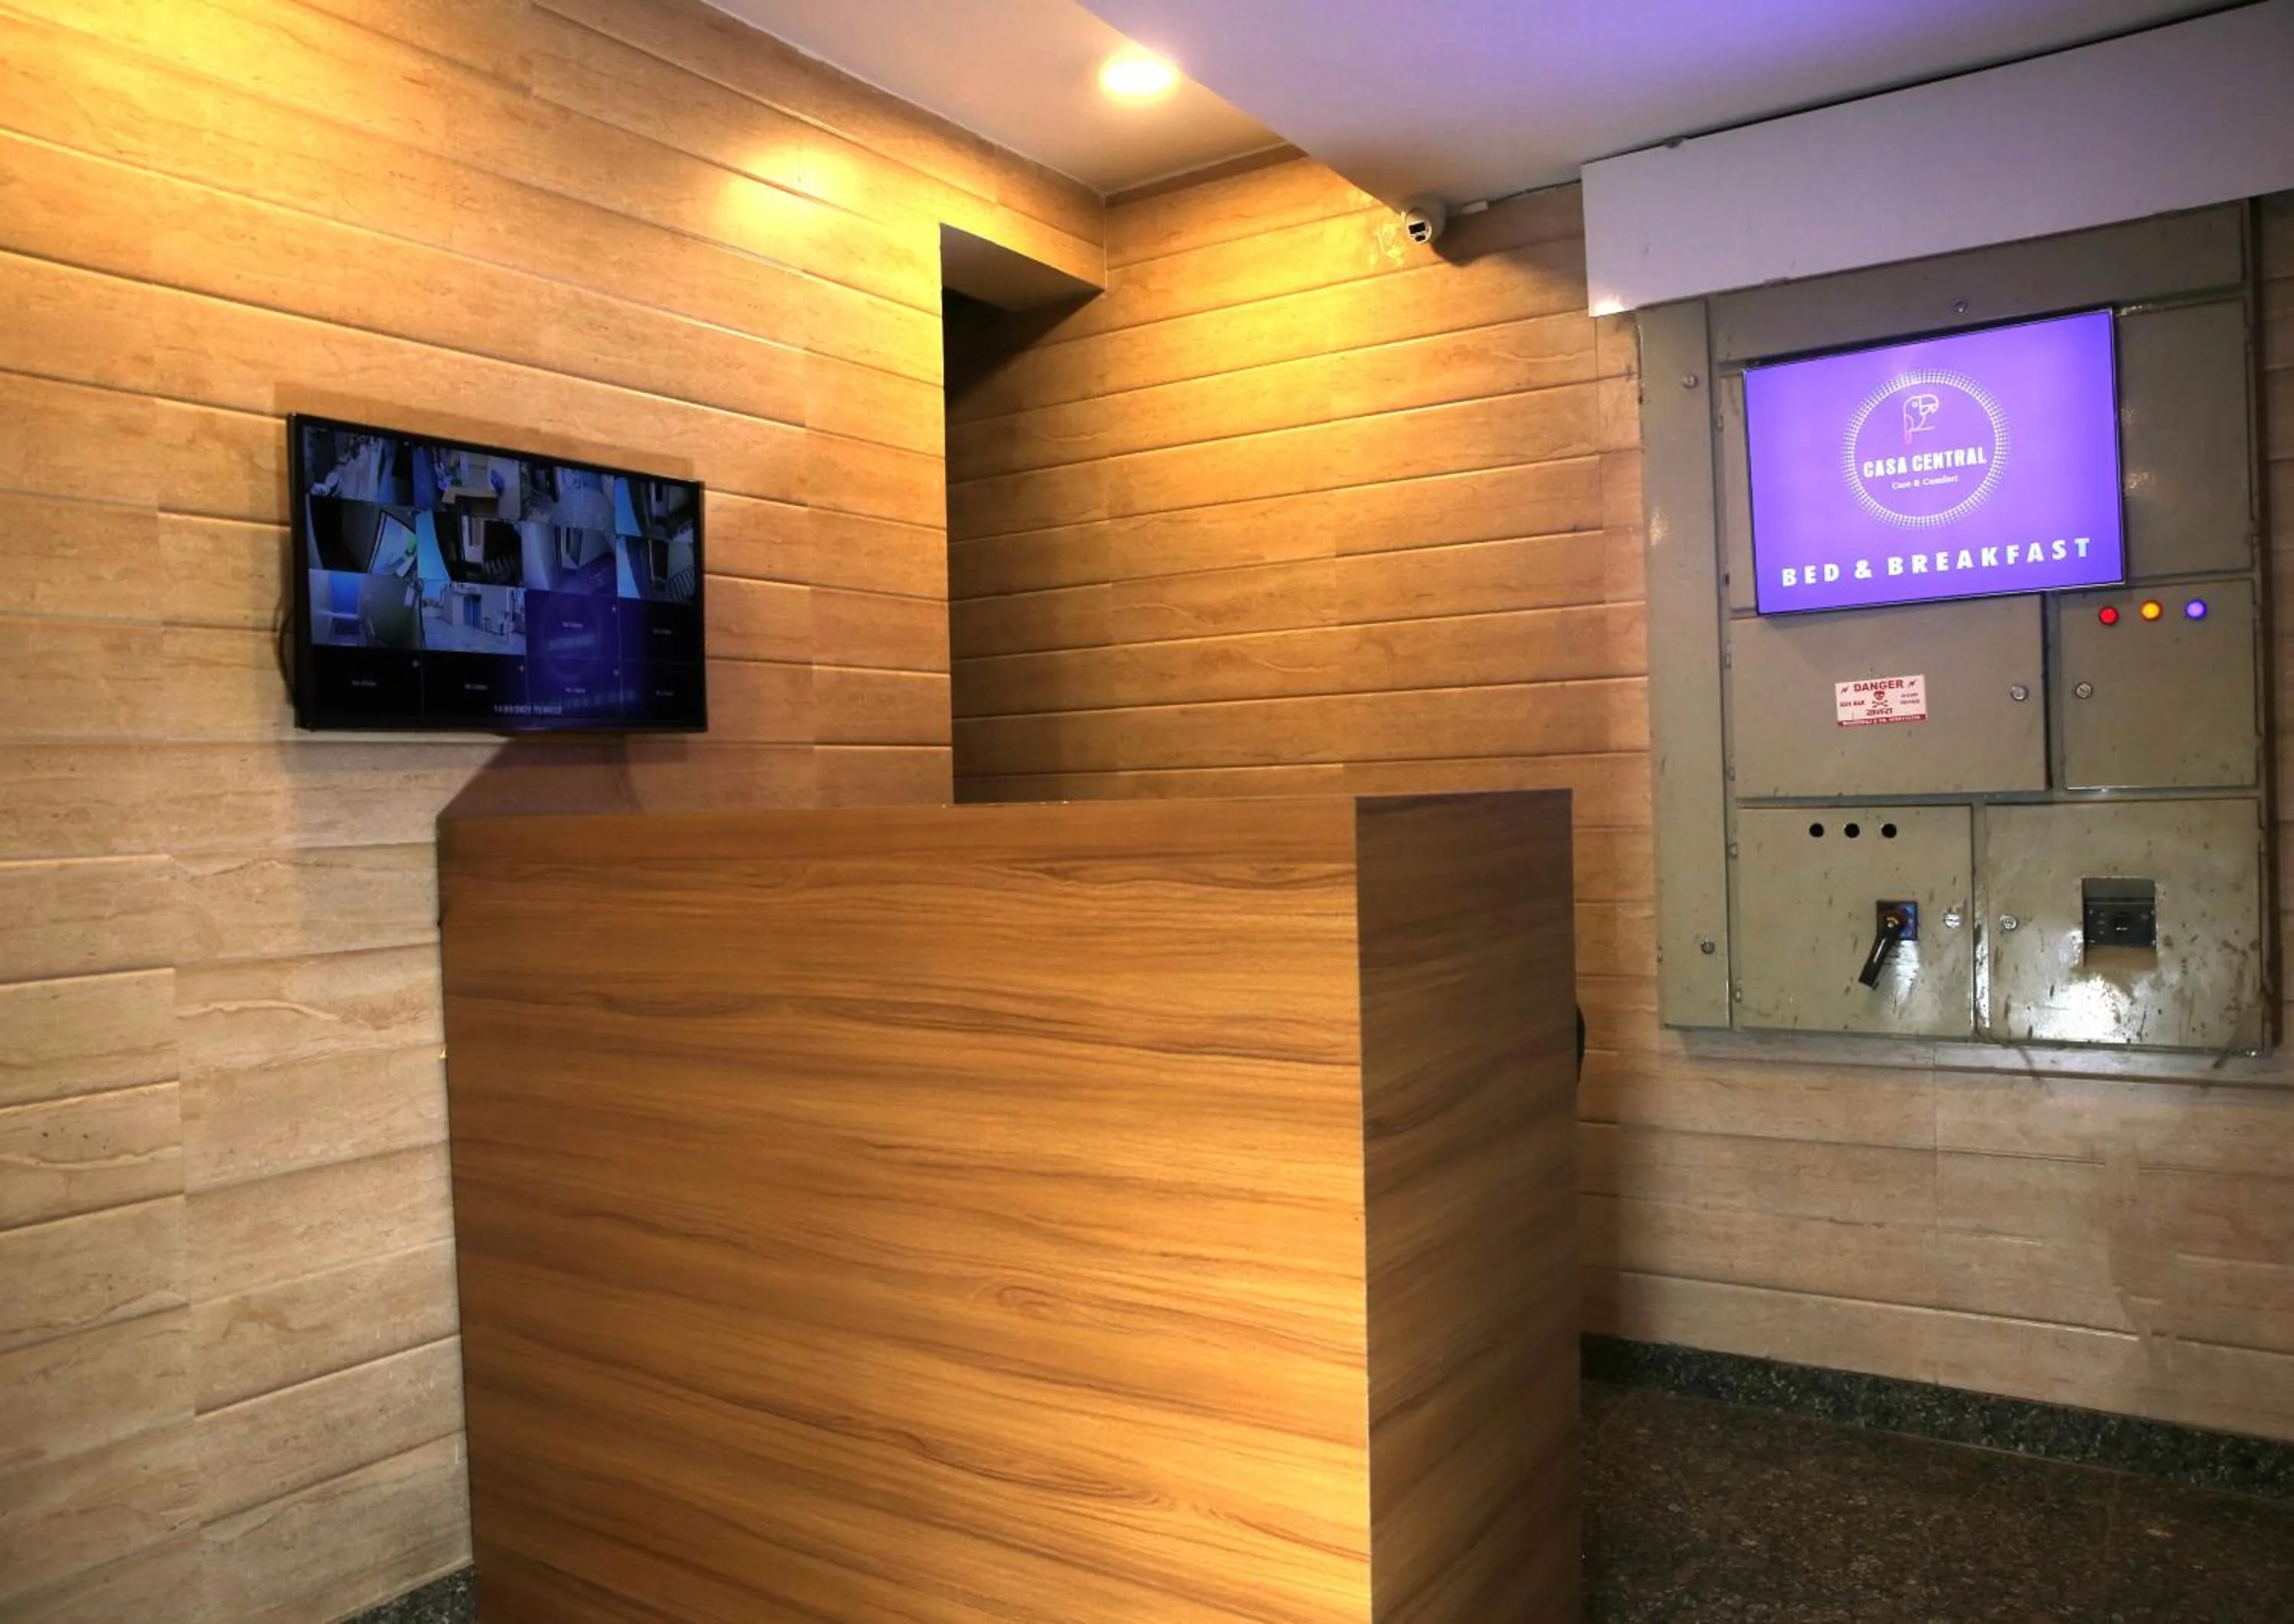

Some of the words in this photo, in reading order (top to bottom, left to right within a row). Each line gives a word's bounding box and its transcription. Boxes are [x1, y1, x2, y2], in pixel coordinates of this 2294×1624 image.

[1863, 457, 1908, 478] CASA
[1912, 447, 1987, 472] CENTRAL
[1782, 564, 1840, 587] BED
[1854, 560, 1873, 579] &
[1887, 538, 2090, 576] BREAKFAST
[1854, 680, 1904, 692] DANGER
